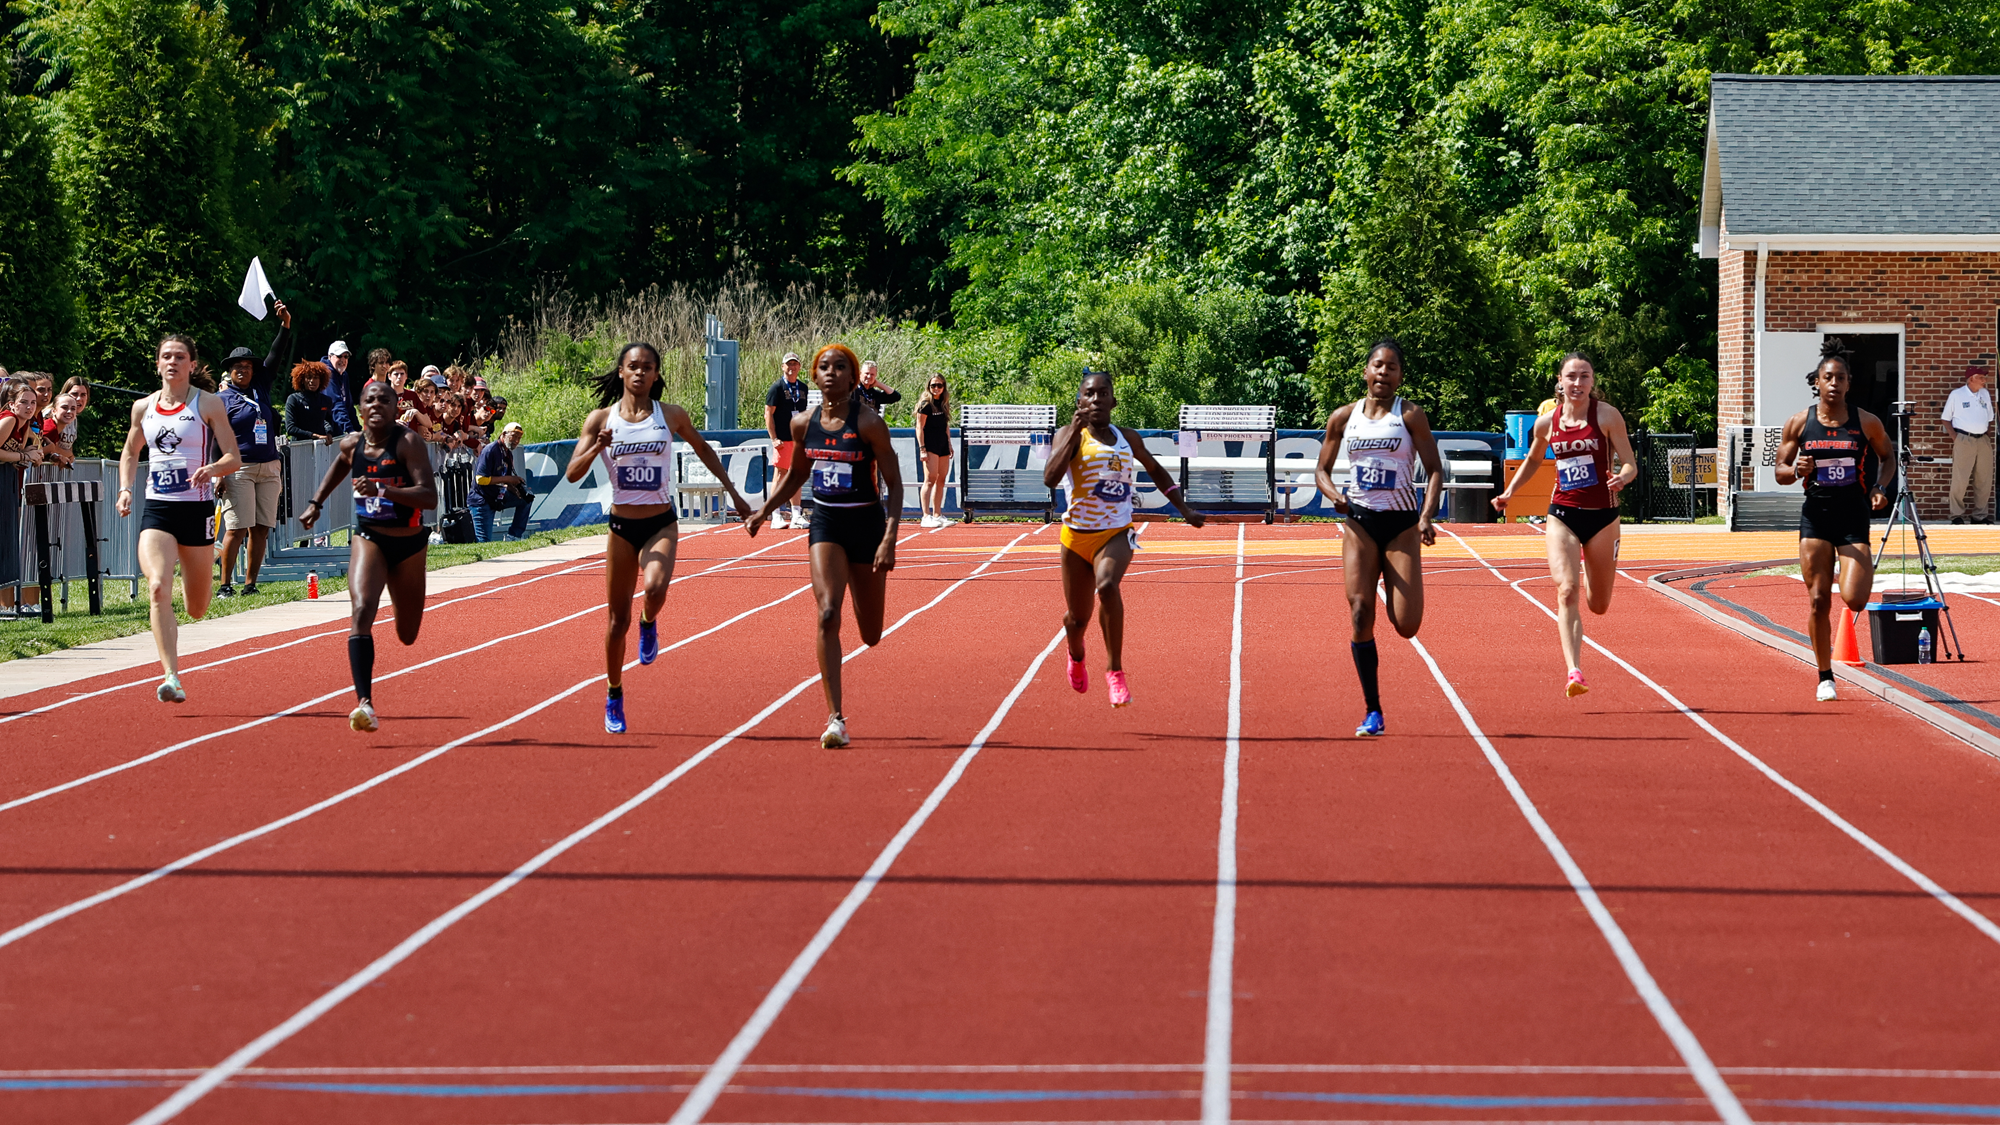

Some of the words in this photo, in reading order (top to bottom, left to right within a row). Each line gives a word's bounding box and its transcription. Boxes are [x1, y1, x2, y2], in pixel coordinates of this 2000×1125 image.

[61, 433, 76, 443] ELO
[1805, 440, 1858, 450] CAMPBELL
[1552, 438, 1599, 454] ELON
[804, 448, 864, 462] AMPBELL
[156, 469, 180, 485] 251
[626, 467, 655, 482] 300
[1362, 468, 1386, 484] 281
[1564, 466, 1589, 482] 128
[1677, 465, 1712, 474] ATHETES
[1828, 466, 1845, 480] 59
[822, 472, 840, 487] 54
[1685, 474, 1704, 482] OLY
[1102, 480, 1124, 496] 223
[365, 498, 382, 514] 64
